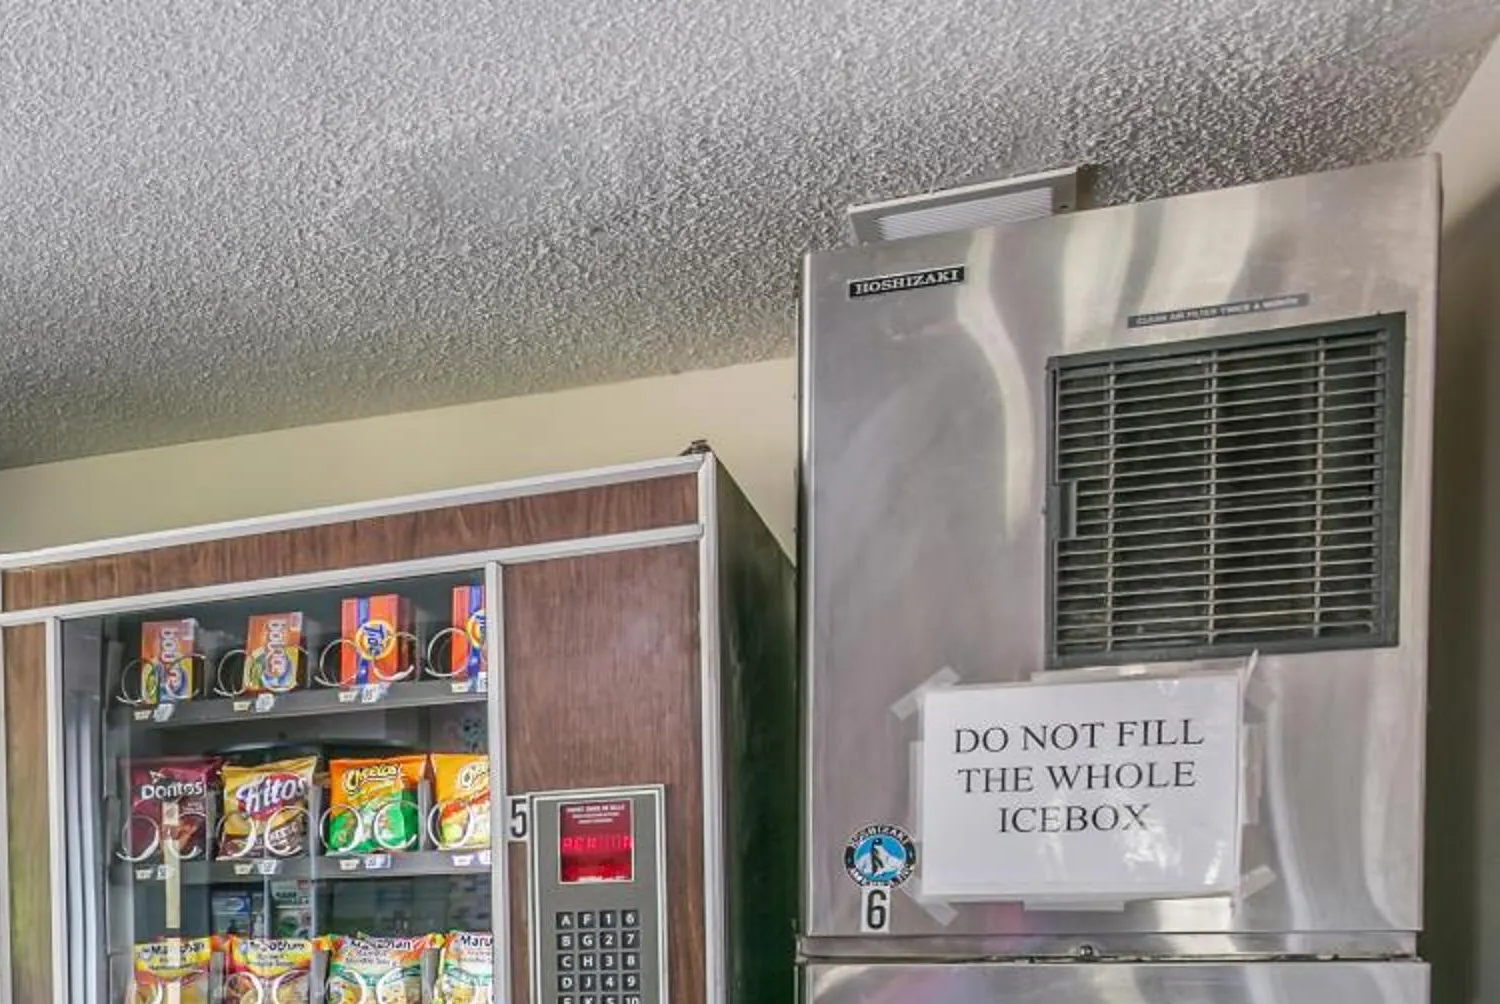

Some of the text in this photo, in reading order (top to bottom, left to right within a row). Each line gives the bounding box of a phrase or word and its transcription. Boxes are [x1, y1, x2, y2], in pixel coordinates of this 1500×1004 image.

[854, 269, 960, 295] HOSHIZAKI
[954, 718, 1205, 754] DO NOT FILL
[957, 761, 1197, 793] THE WHOLE
[141, 780, 205, 801] Doritos
[236, 777, 308, 817] Fritos
[510, 799, 527, 839] 5
[998, 803, 1150, 833] ICEBOX
[561, 914, 571, 927] A
[583, 913, 592, 926] F
[605, 913, 611, 925] 1
[867, 888, 887, 930] 6
[460, 934, 493, 947] Maru
[583, 934, 593, 947] G
[605, 934, 613, 945] 2
[627, 933, 635, 945] 7
[562, 955, 572, 968] C
[583, 955, 593, 967] H
[605, 955, 613, 967] 3
[562, 975, 636, 989] D J 4 9
